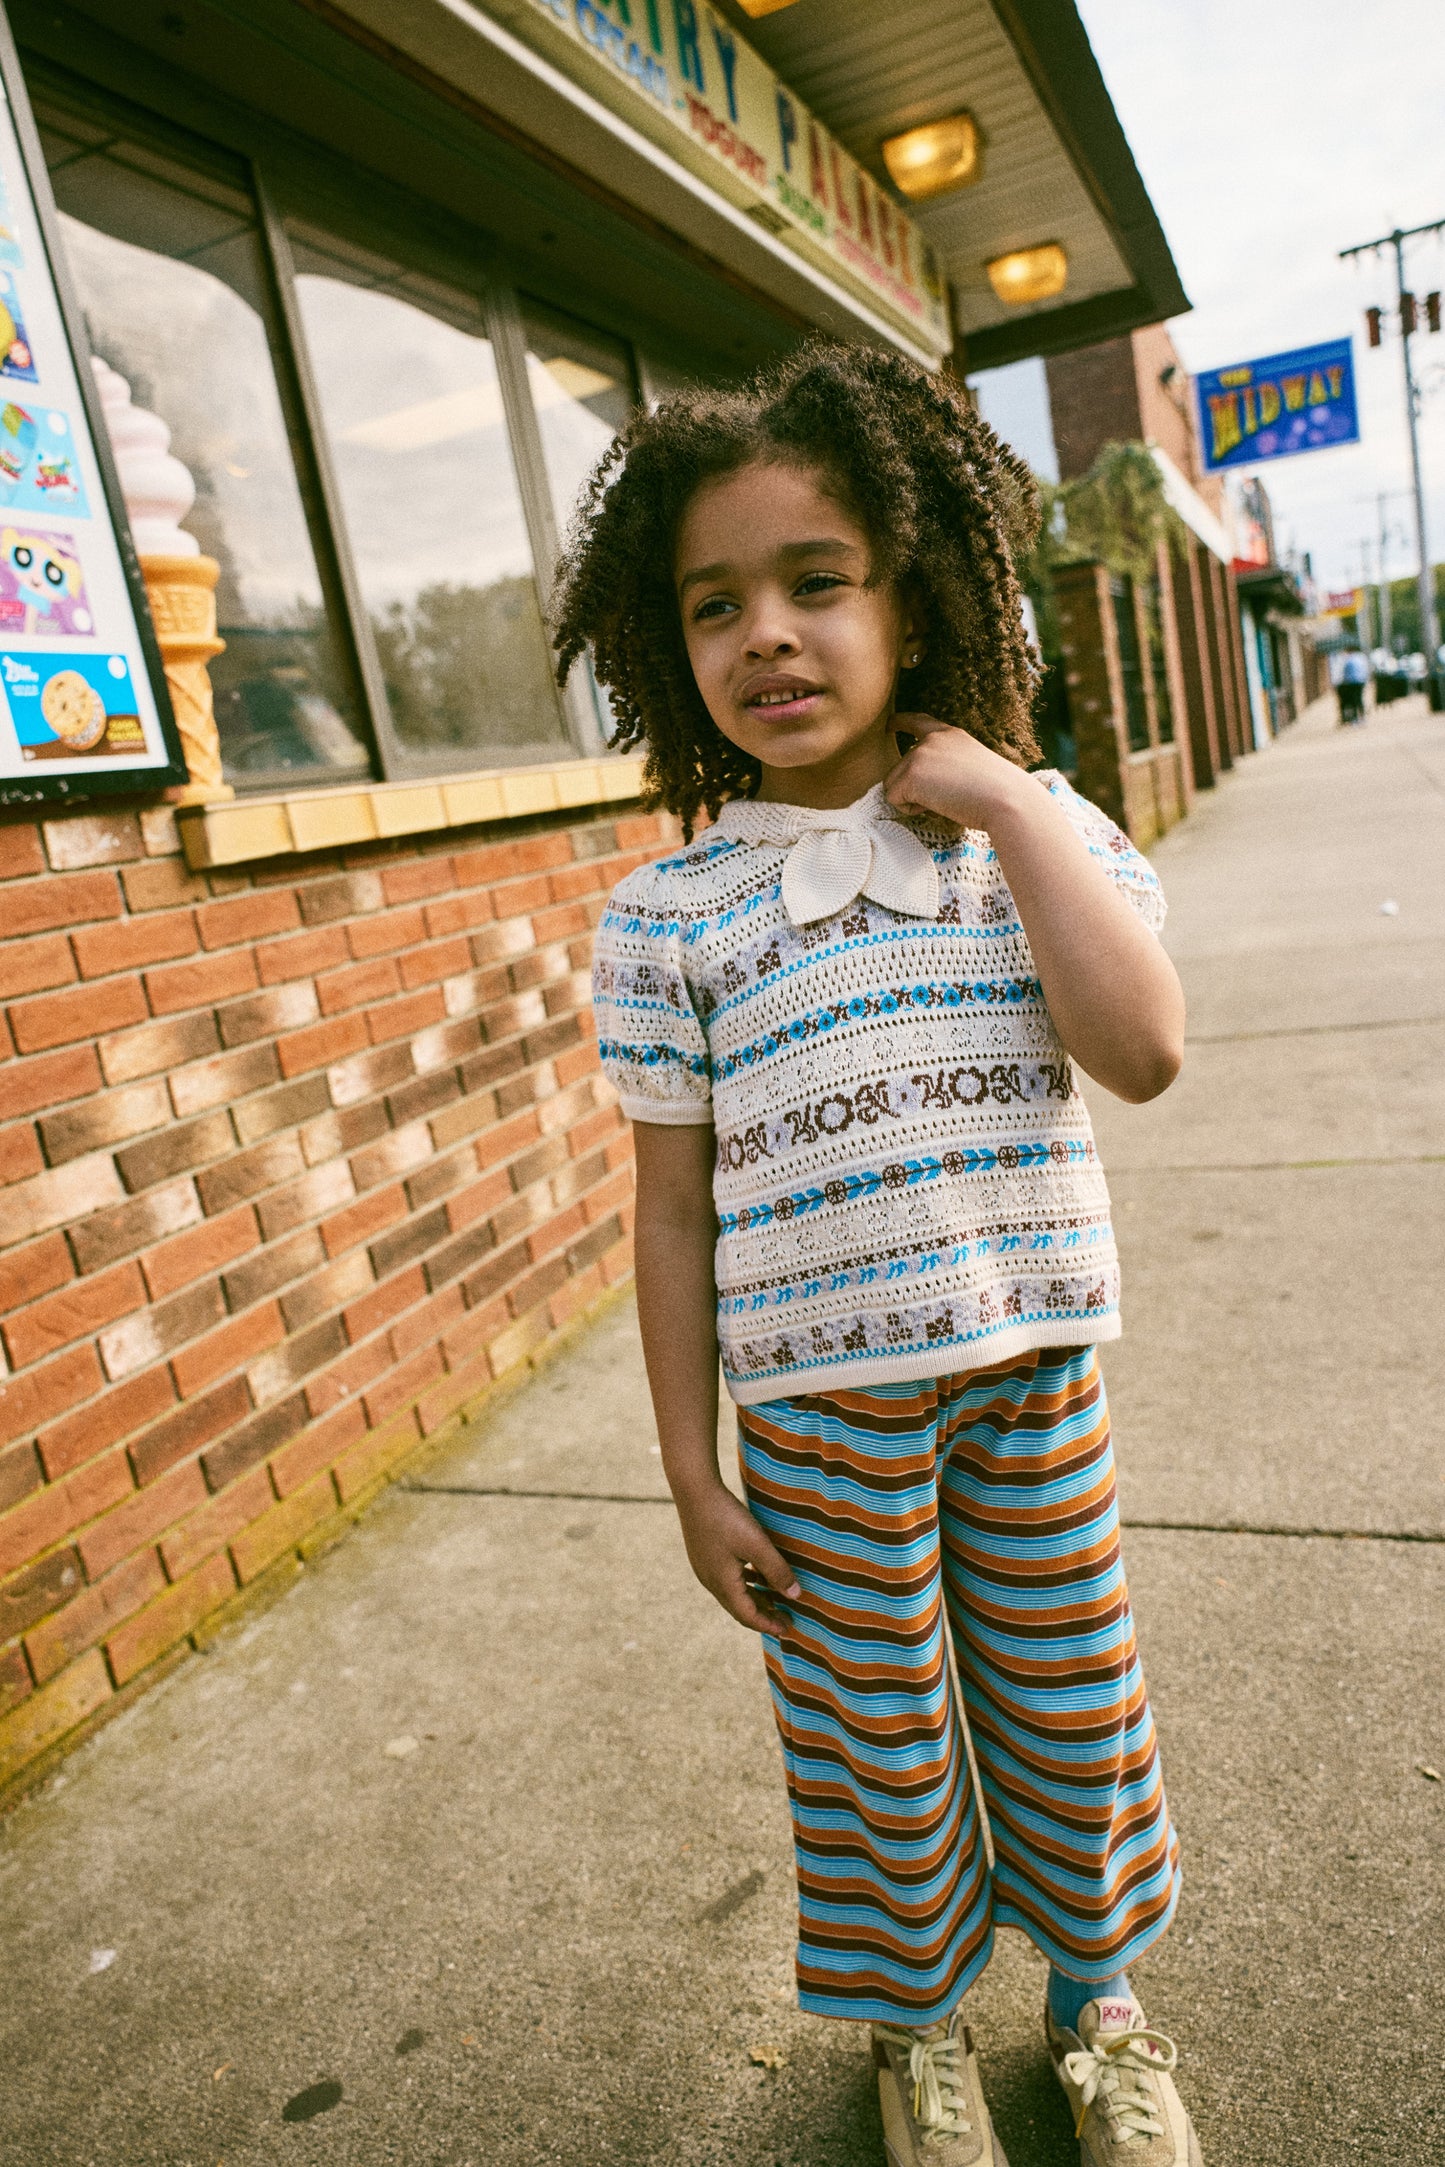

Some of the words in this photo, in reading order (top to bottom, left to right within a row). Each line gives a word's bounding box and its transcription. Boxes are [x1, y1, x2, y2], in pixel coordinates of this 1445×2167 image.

[602, 0, 738, 124] IRY
[1208, 366, 1343, 460] MIDWAY
[1102, 2006, 1131, 2023] PONY
